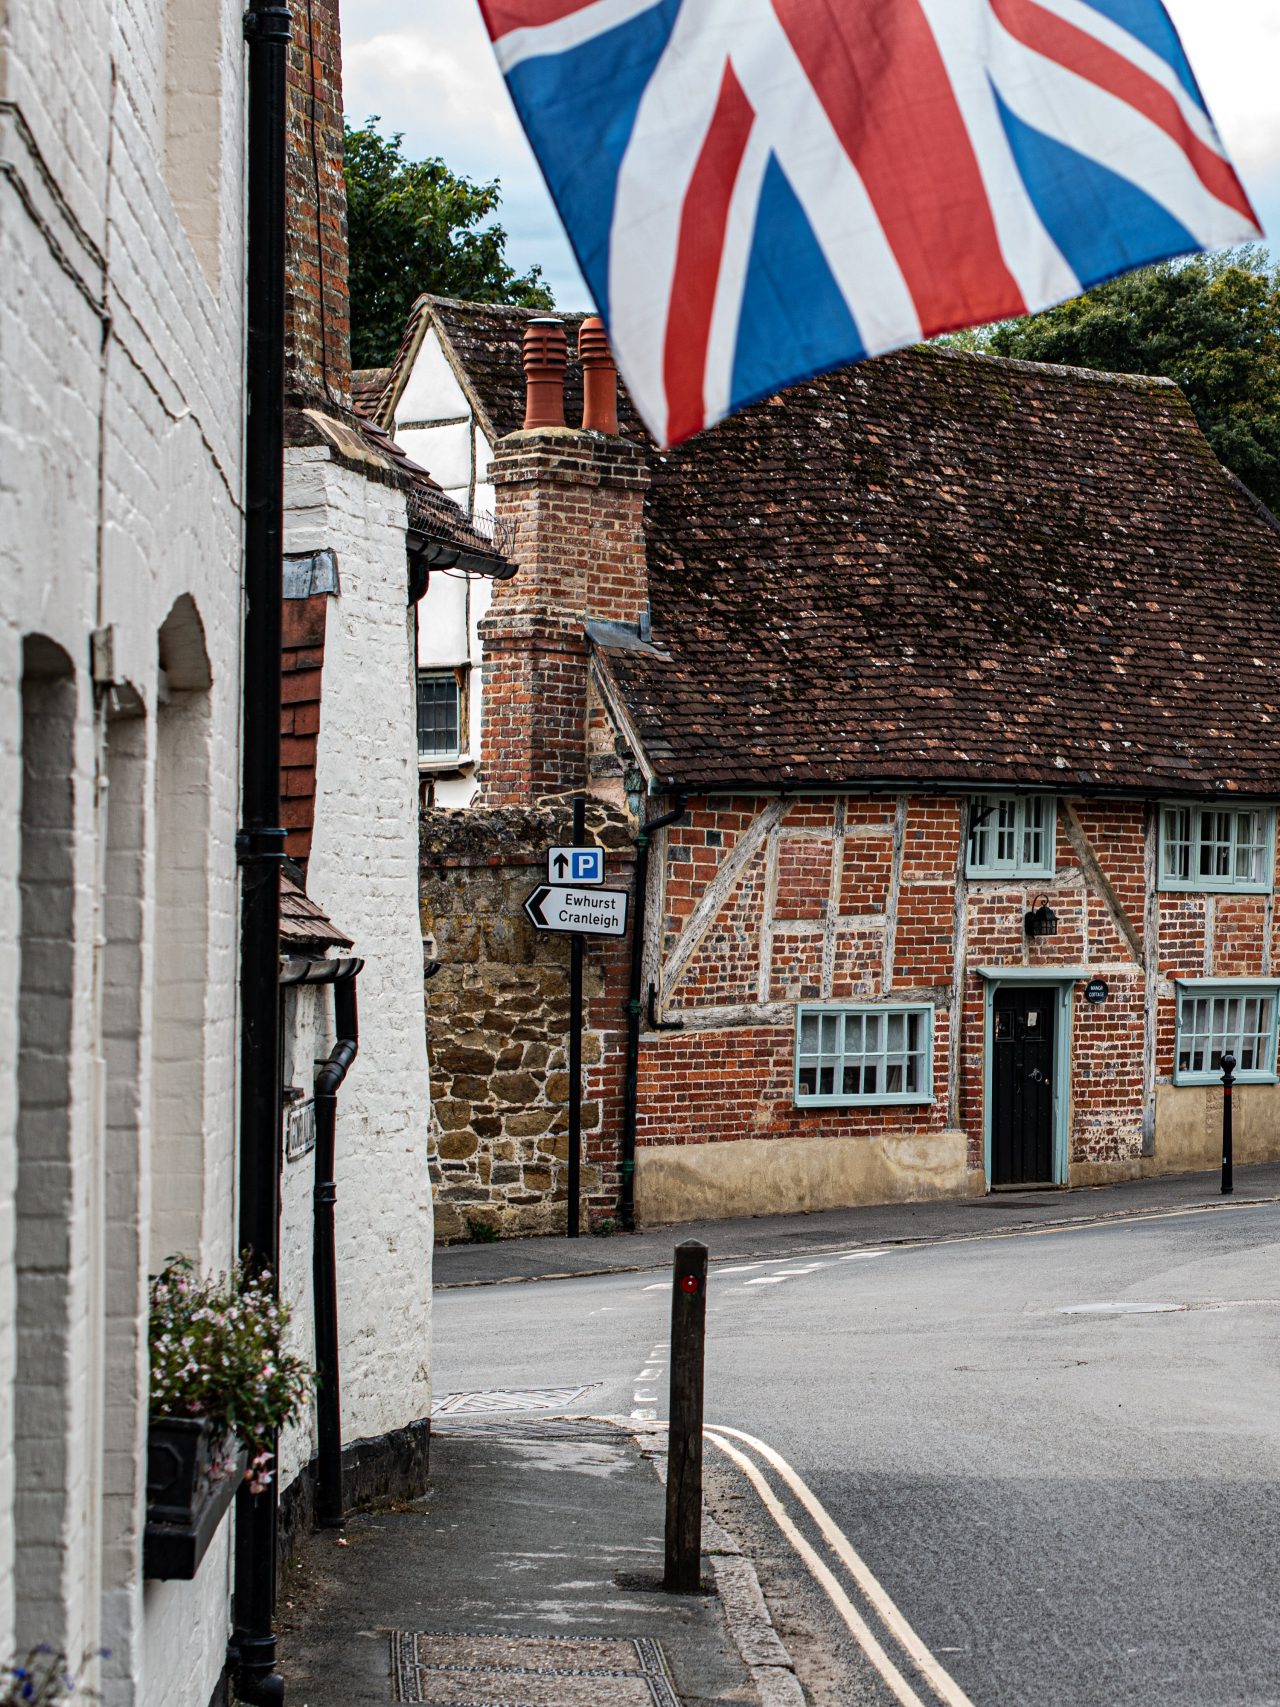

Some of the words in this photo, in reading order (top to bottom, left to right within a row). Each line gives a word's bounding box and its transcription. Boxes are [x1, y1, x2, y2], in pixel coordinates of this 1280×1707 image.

[578, 855, 594, 876] P
[565, 893, 616, 910] Ewhurst
[558, 909, 619, 928] Cranleigh
